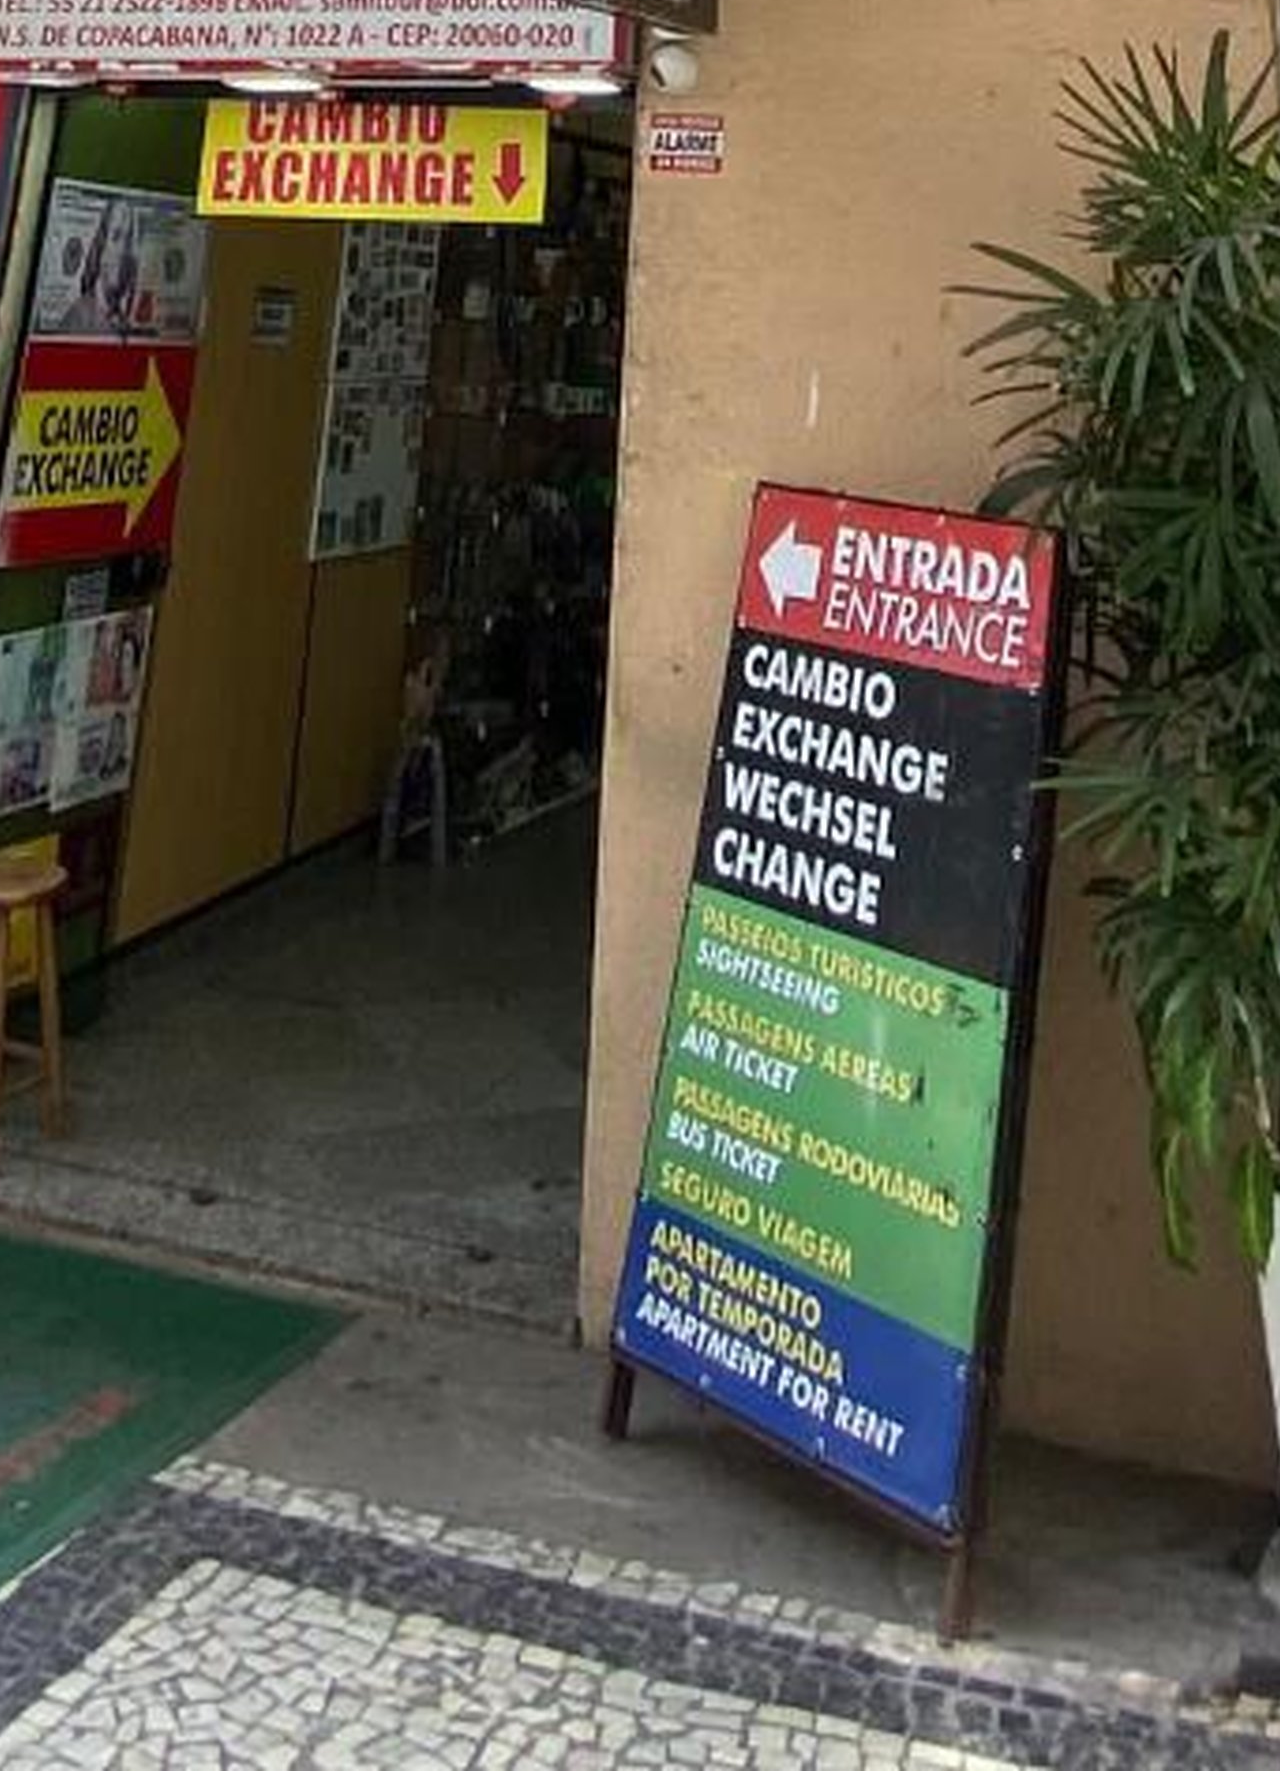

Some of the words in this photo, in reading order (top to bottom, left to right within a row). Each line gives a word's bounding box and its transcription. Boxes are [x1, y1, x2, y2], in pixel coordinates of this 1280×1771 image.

[41, 25, 69, 47] DE
[287, 23, 341, 47] 1022
[347, 23, 365, 47] A
[211, 149, 475, 208] EXCHANGE
[38, 404, 140, 448] CAMBIO
[13, 449, 150, 499] EXCHANGE
[831, 525, 1031, 610] ENTRADA
[823, 582, 1027, 668] ENTRANCE
[743, 644, 896, 720] CAMBIO
[733, 702, 949, 803] EXCHANGE
[723, 761, 897, 861] WECHSEL
[713, 827, 881, 926] CHANGE
[700, 906, 803, 965] PASSEIOS
[696, 938, 841, 1016] SIGHTSEEING
[681, 1024, 721, 1061] AIR
[723, 1037, 799, 1096] TICKET
[687, 988, 815, 1065] PASSAGENS
[667, 1110, 707, 1151] BUS
[710, 1123, 783, 1186] TICKET
[673, 1074, 793, 1155] PASSAGENS
[660, 1162, 751, 1226] SEGURO
[758, 1206, 853, 1280] VIAGEM
[650, 1219, 822, 1330] APARTAMENTO
[644, 1255, 689, 1303] POR
[696, 1284, 845, 1388] TEMPORADA
[637, 1291, 776, 1388] APARTMENT
[776, 1367, 829, 1421] FOR
[833, 1398, 907, 1458] RENT
